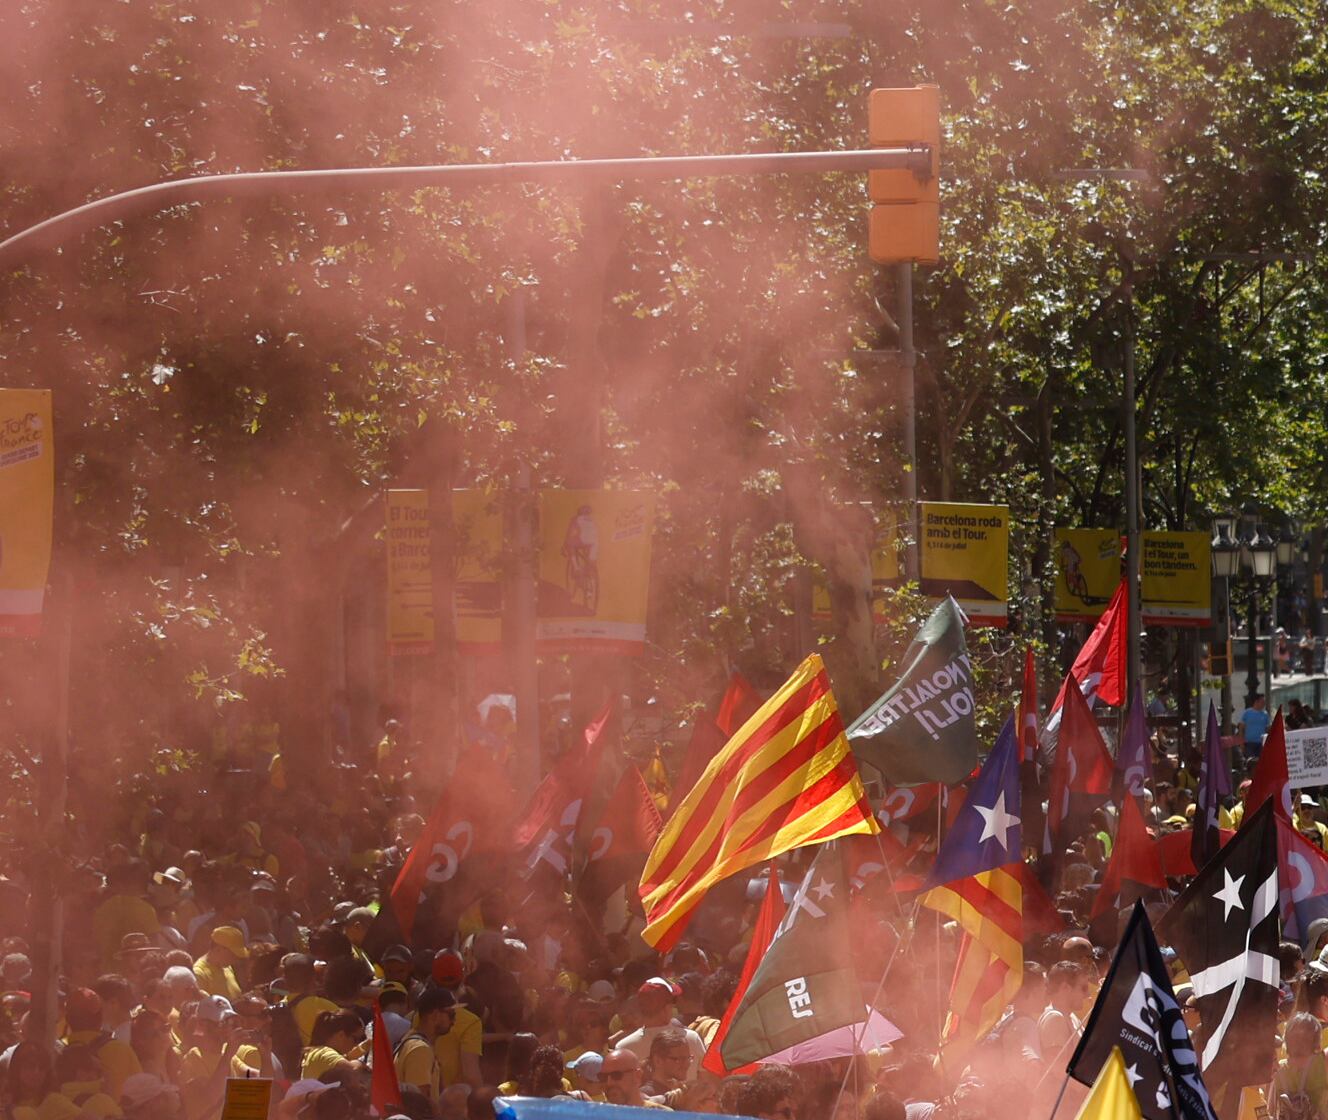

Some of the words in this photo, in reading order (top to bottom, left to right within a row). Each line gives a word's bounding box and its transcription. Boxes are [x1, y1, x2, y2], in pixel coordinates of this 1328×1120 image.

[927, 513, 977, 526] Barcelona
[979, 516, 1002, 528] roda
[927, 527, 950, 538] amb
[953, 528, 961, 539] el
[784, 977, 813, 1019] REJ
